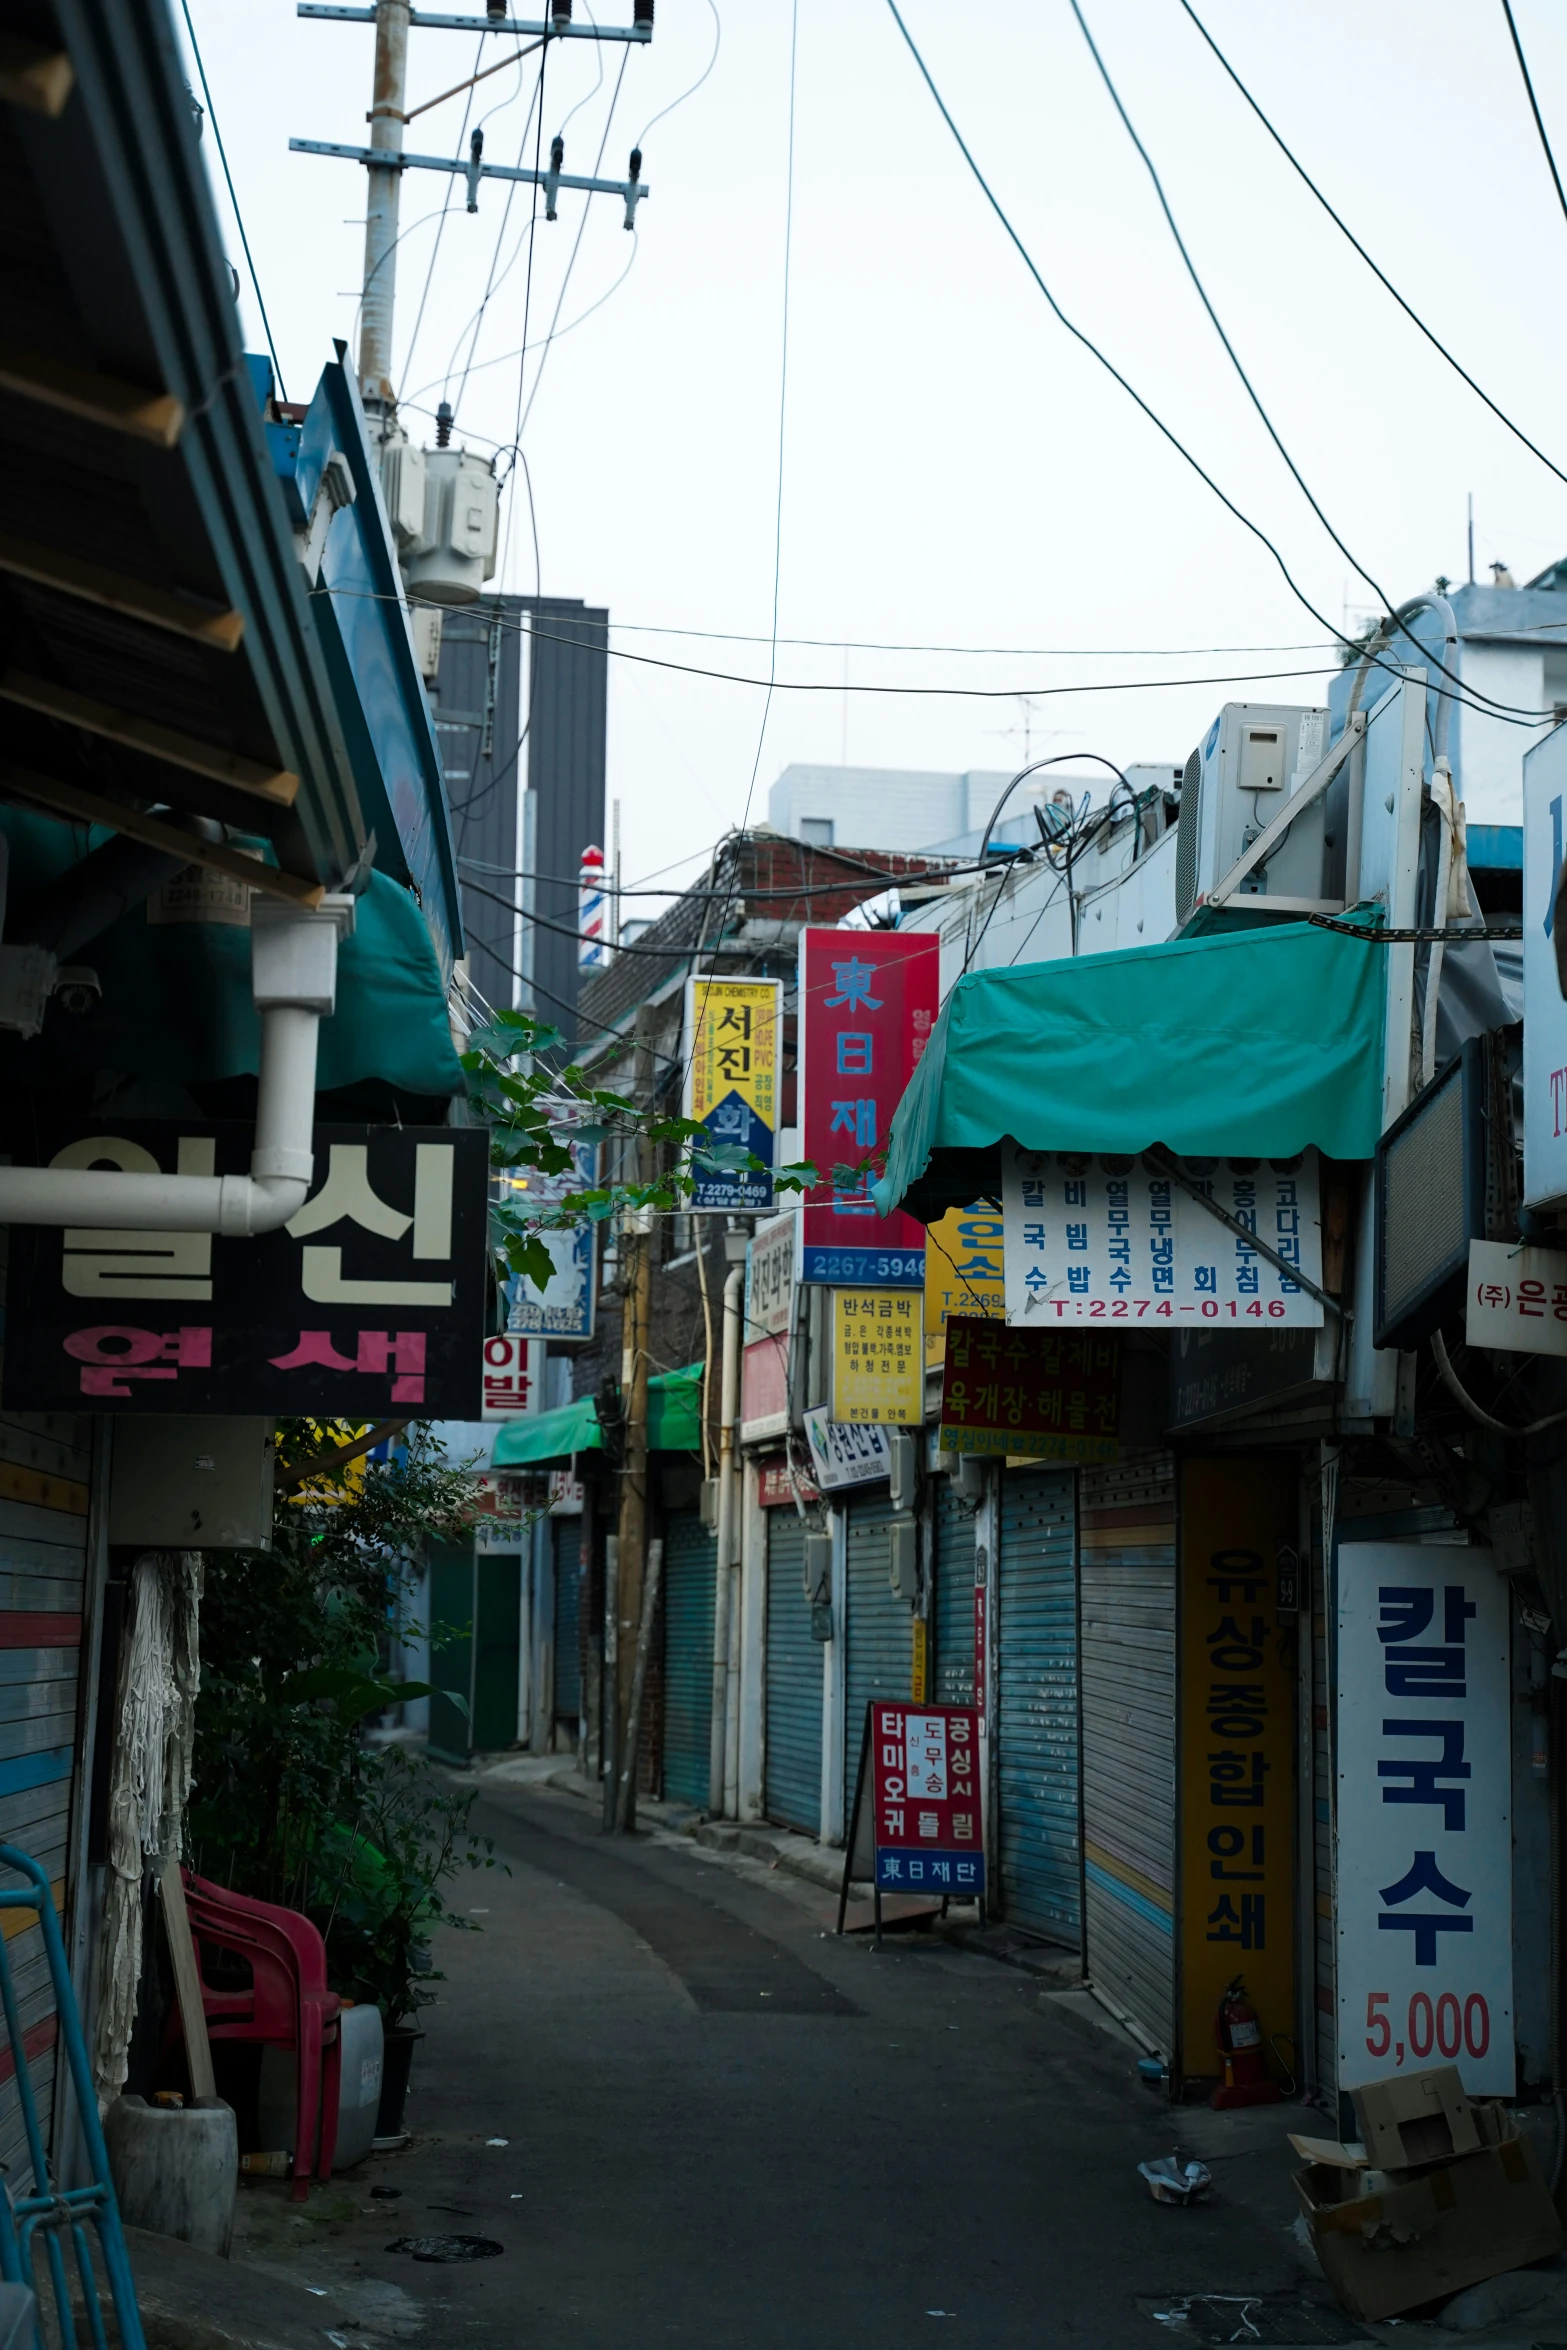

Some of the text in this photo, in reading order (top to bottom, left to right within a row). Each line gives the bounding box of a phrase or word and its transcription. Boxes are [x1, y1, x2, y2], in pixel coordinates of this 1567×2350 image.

[754, 1049, 773, 1068] PVC
[1021, 1180, 1048, 1292] 칼국수
[1063, 1180, 1091, 1293] 비빔밥
[1105, 1180, 1132, 1294] 열무국수
[1147, 1180, 1175, 1294] 열무냉면
[1232, 1180, 1259, 1294] 홍어무침
[843, 1298, 912, 1319] 반석금박
[1049, 1300, 1286, 1318] T:2274-0146
[484, 1338, 533, 1410] 이발
[1376, 1585, 1477, 1967] 칼국수
[1365, 1992, 1491, 2067] 5,000
